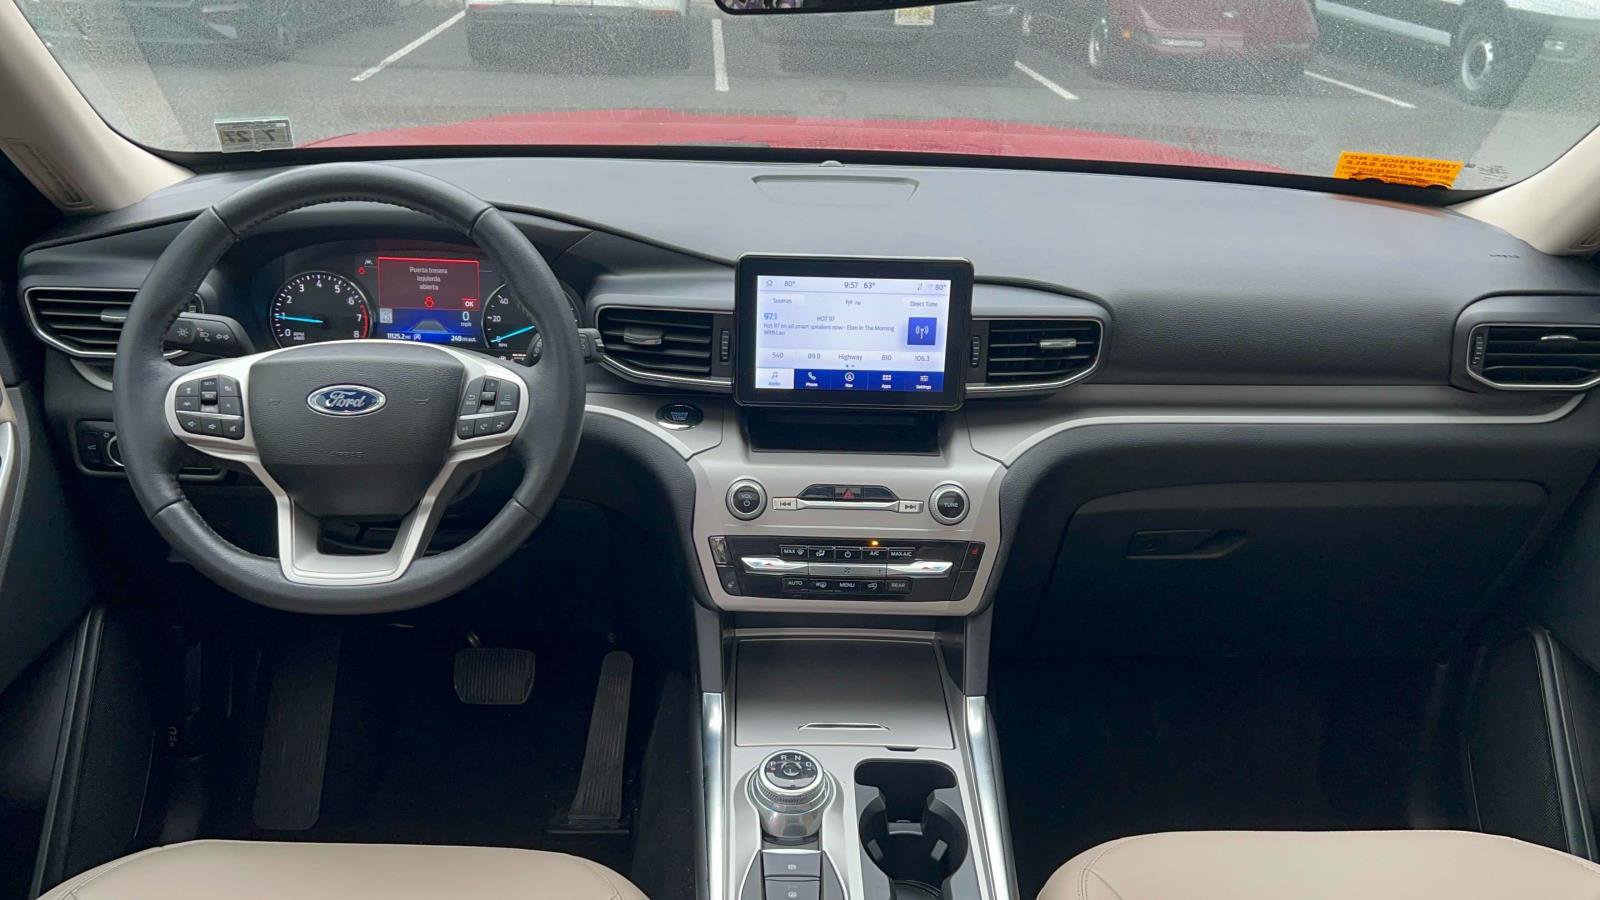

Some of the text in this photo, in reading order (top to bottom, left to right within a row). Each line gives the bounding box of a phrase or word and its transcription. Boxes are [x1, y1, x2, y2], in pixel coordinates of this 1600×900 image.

[299, 284, 304, 292] 3
[316, 280, 322, 288] 4
[334, 284, 340, 293] 5
[286, 296, 292, 304] 2
[348, 297, 354, 305] 6
[462, 311, 470, 321] 0
[284, 328, 290, 336] 0
[325, 390, 366, 408] Ford
